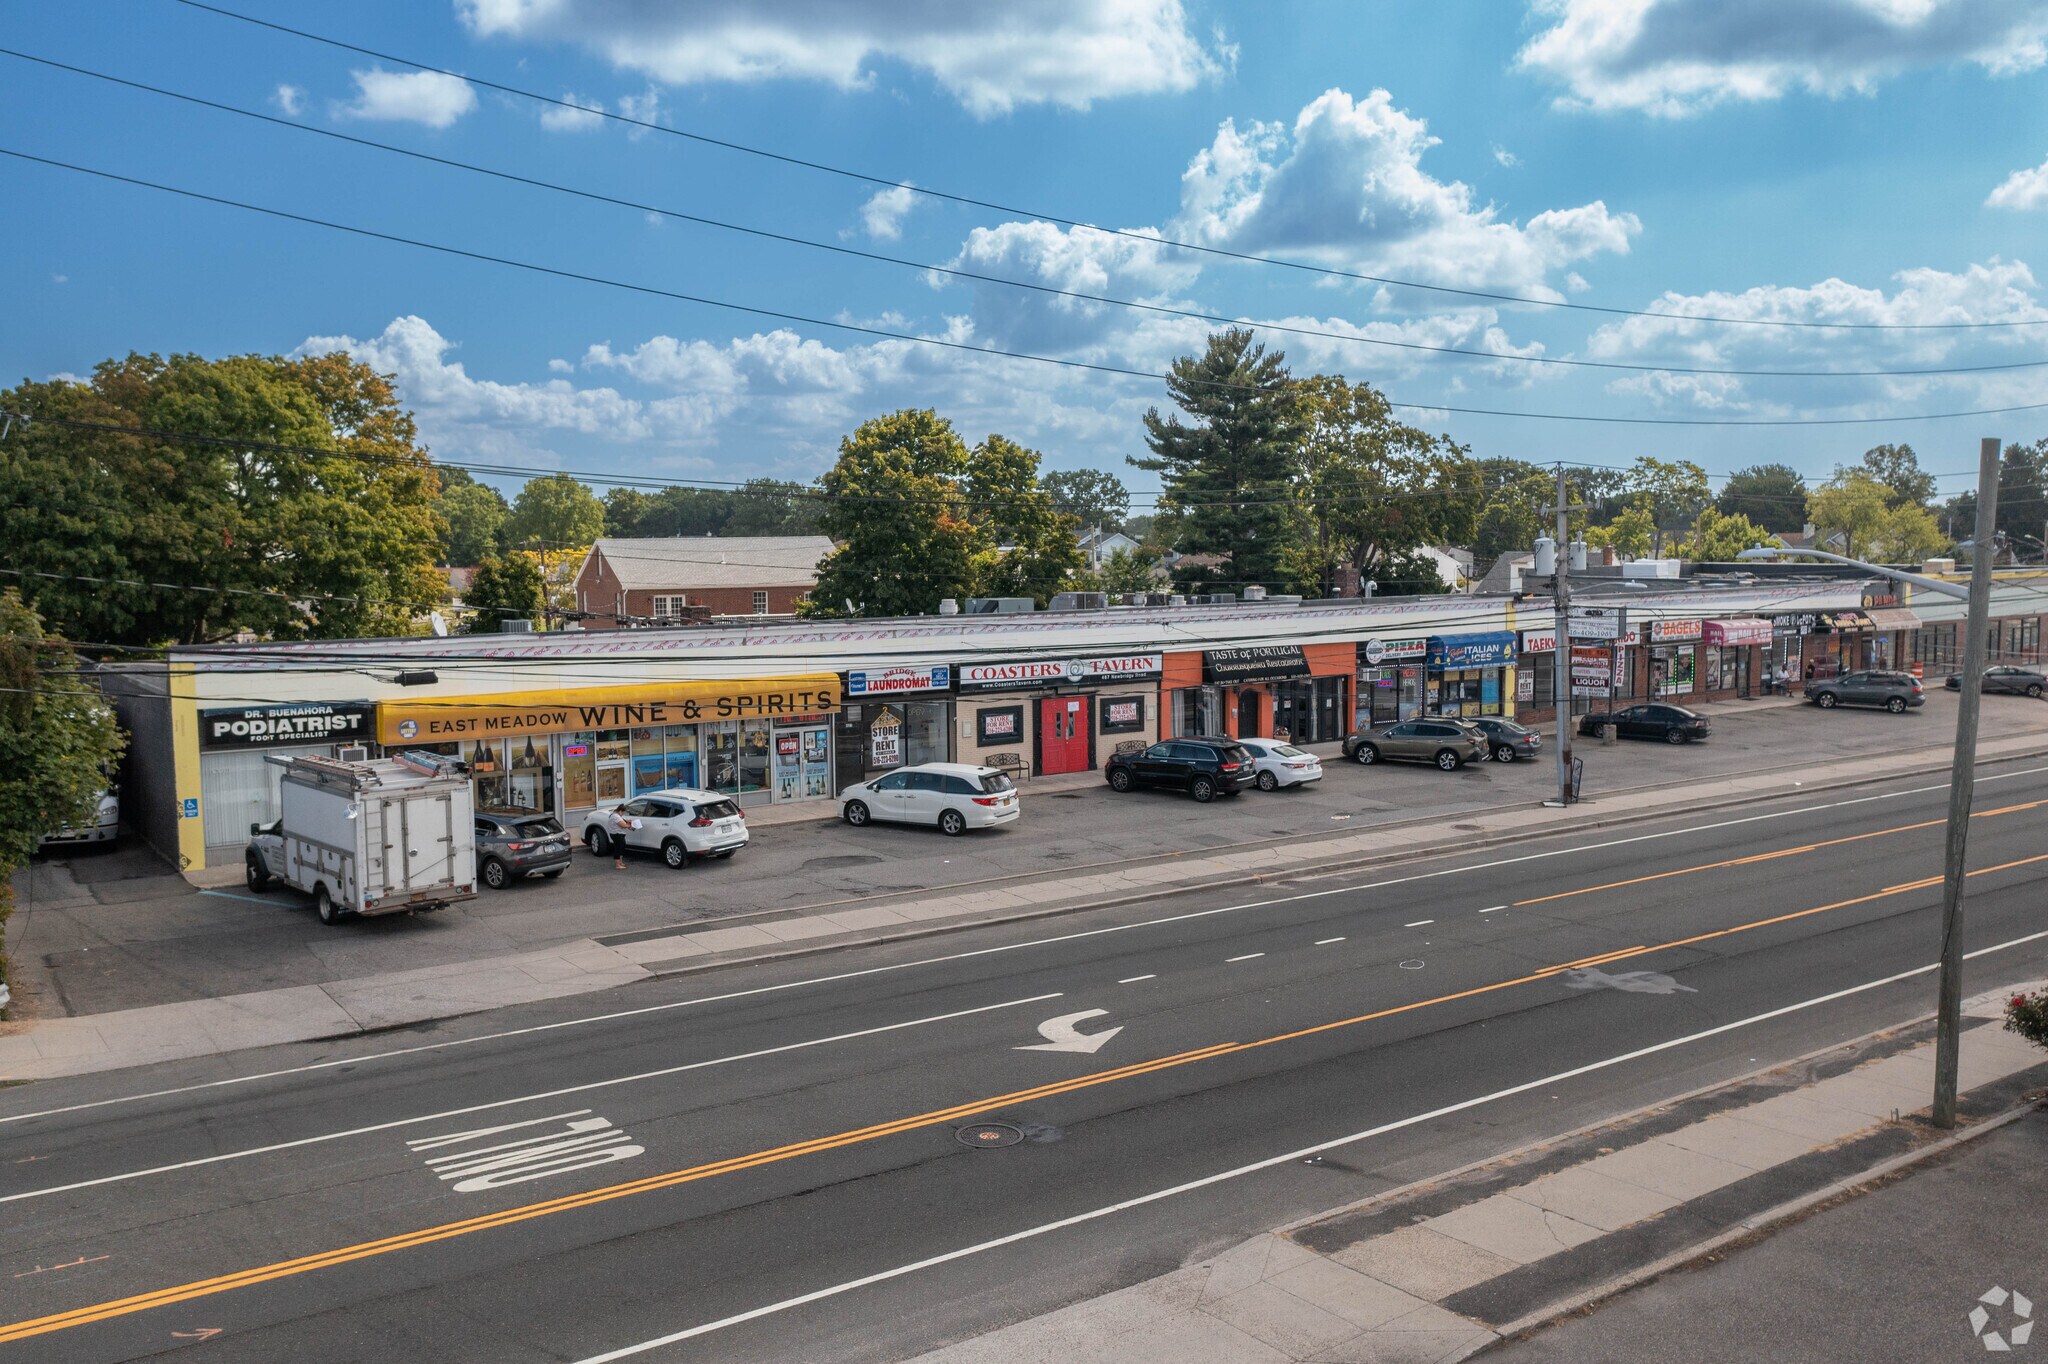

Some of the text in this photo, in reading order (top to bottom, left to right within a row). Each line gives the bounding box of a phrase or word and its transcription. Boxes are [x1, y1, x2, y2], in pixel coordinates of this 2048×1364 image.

[1773, 615, 1789, 627] SMOKE
[1663, 620, 1701, 636] BAGELS
[1385, 640, 1425, 652] PIZZA
[1464, 644, 1500, 655] ITALIAN
[1528, 638, 1556, 651] TAEKW
[1210, 649, 1238, 660] TASTE
[1252, 645, 1301, 657] PORTUGAL
[1471, 652, 1492, 662] ICES
[971, 657, 1153, 681] COASTERS TAVERN
[1265, 658, 1304, 668] Restaurant
[1616, 646, 1624, 684] PIZZA
[883, 668, 917, 679] BRIDGE
[1519, 671, 1533, 679] STORE
[867, 676, 931, 691] LAUNDROMAT
[1575, 678, 1605, 686] LIQUOR
[244, 706, 334, 718] DR. BUENAHORA
[430, 690, 832, 734] EAST MEADOW WINE & SPIRITS
[214, 714, 362, 737] PODIATRIST
[872, 725, 898, 737] STORE
[279, 731, 329, 740] SPECIALIST
[780, 741, 797, 750] OPEN
[875, 740, 896, 751] RENT
